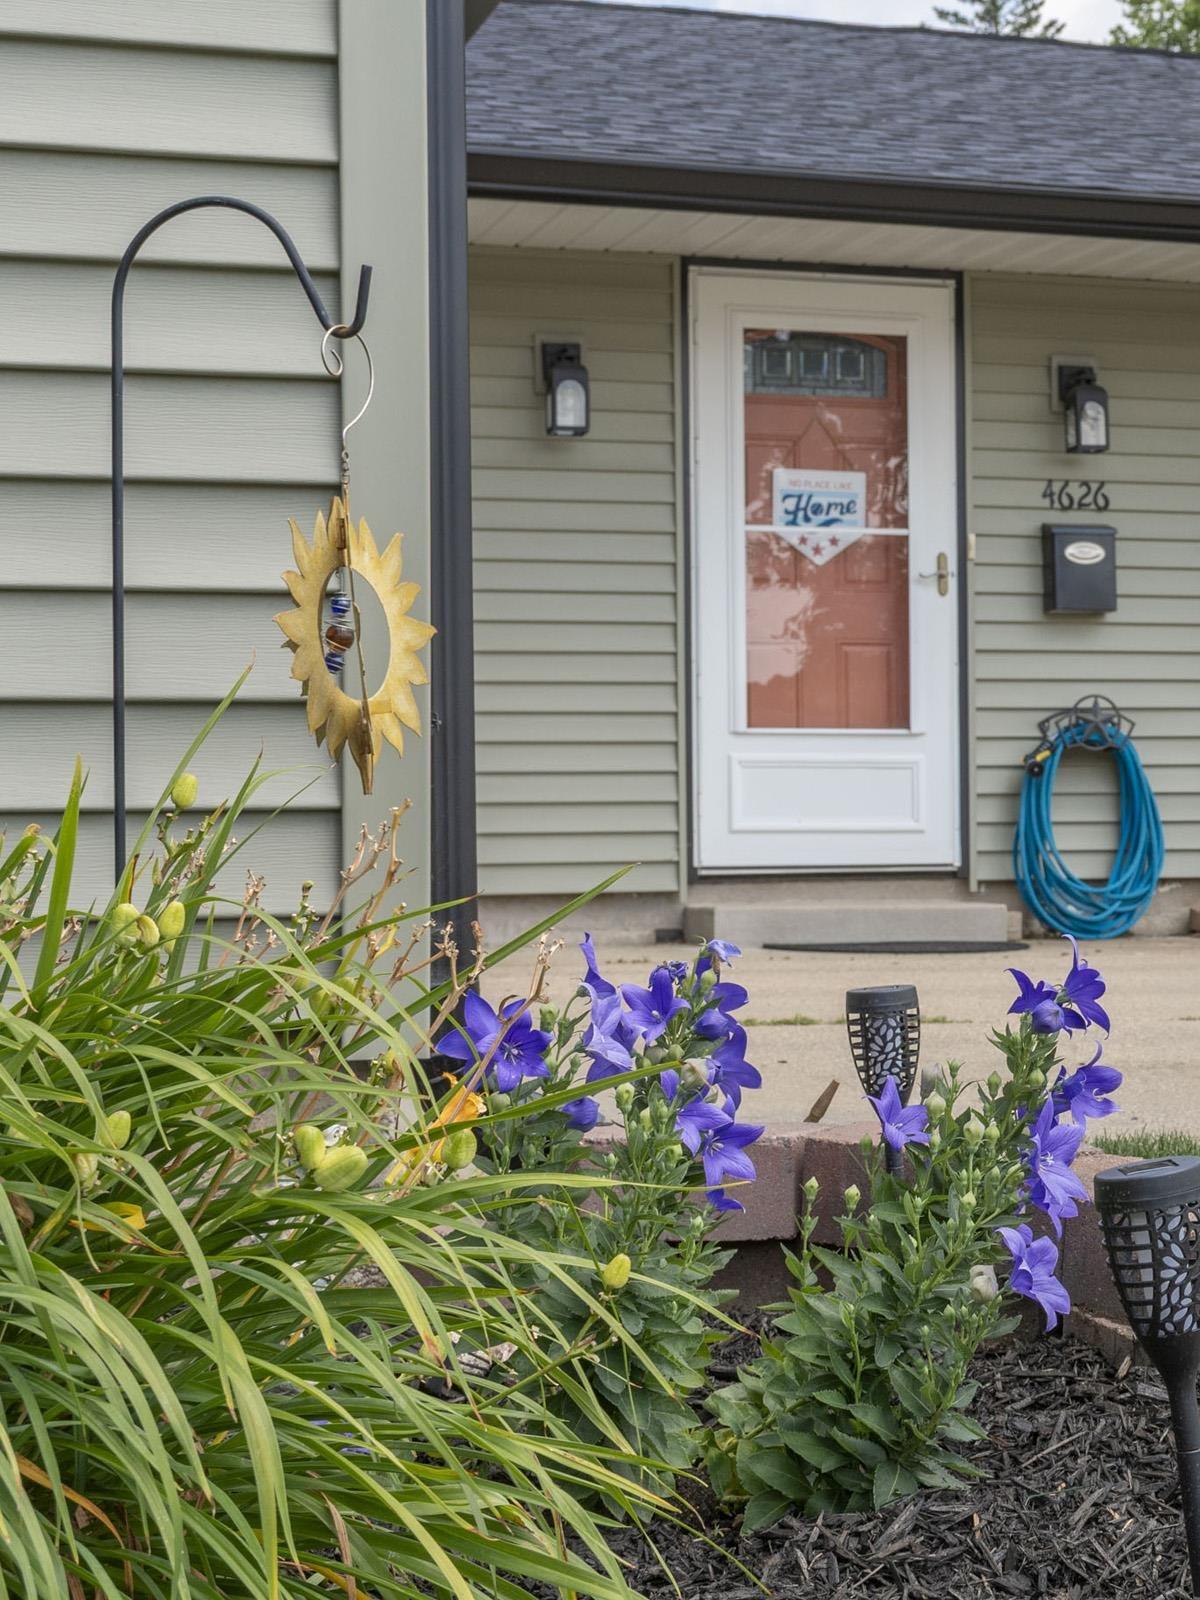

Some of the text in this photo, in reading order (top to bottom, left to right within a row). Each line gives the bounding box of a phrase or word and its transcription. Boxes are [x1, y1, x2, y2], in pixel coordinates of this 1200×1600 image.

[803, 479, 831, 489] PLACE
[1042, 479, 1110, 511] 4626
[782, 493, 857, 526] Home
